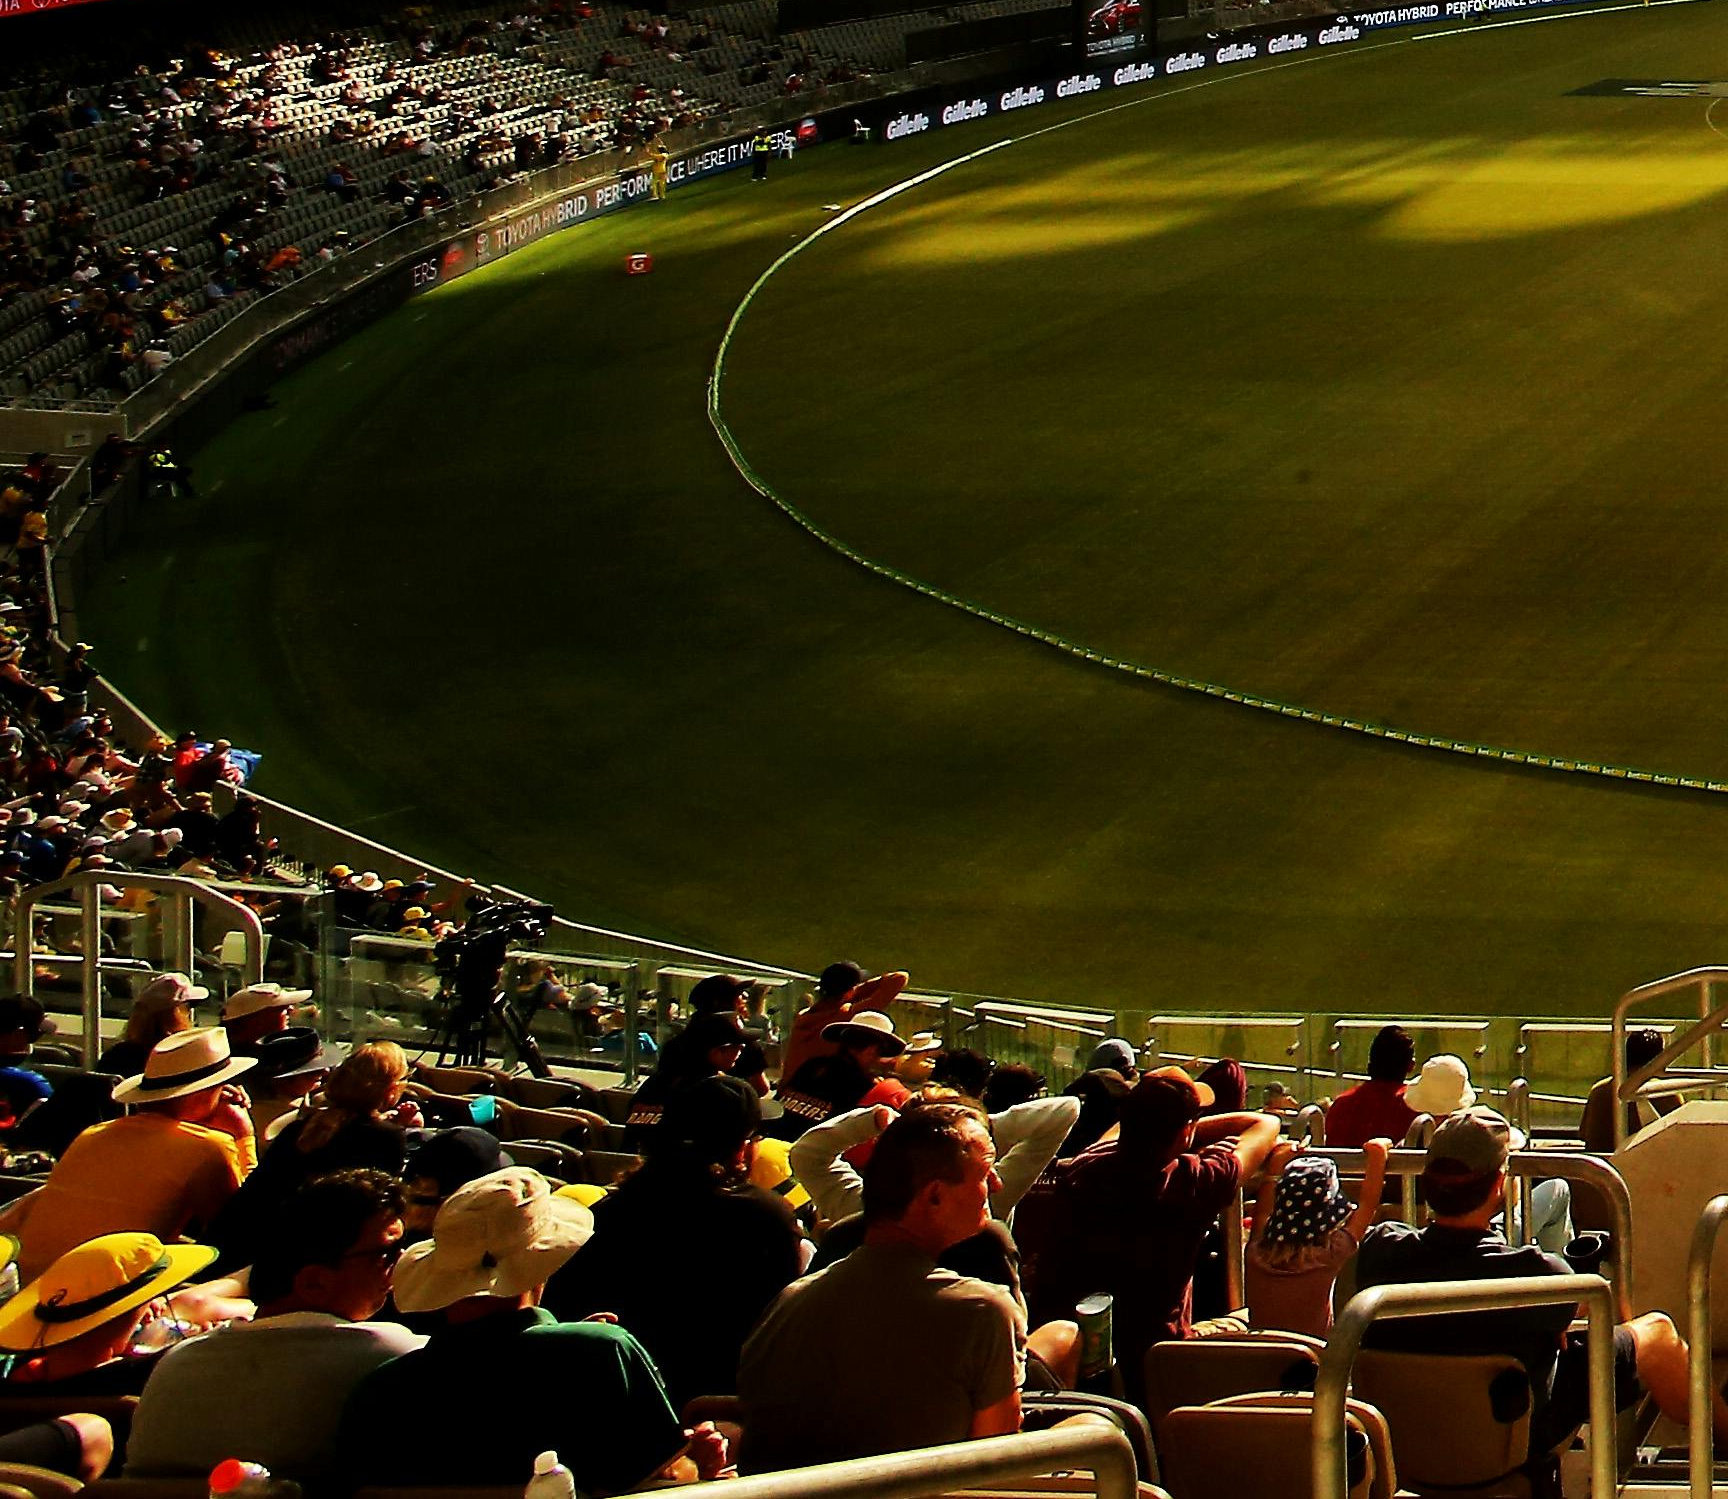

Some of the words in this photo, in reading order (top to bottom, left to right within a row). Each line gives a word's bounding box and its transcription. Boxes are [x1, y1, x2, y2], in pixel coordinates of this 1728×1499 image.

[1398, 4, 1438, 22] HYBRID
[887, 113, 929, 140] Gillette
[943, 99, 987, 124] Gillette
[1000, 86, 1044, 111] Gillette
[1057, 75, 1101, 98] Gillette
[1113, 63, 1154, 86] Gillette
[1166, 53, 1205, 74] Gillette
[1216, 42, 1257, 64] Gillette
[1268, 33, 1308, 54] Gillette
[1319, 25, 1359, 45] Gillette
[496, 218, 541, 249] TOYOTA
[542, 195, 588, 228] HYBRID
[596, 164, 685, 208] PERFORMNCE
[688, 149, 726, 175] WHERE
[727, 145, 738, 163] IT
[631, 257, 645, 270] G
